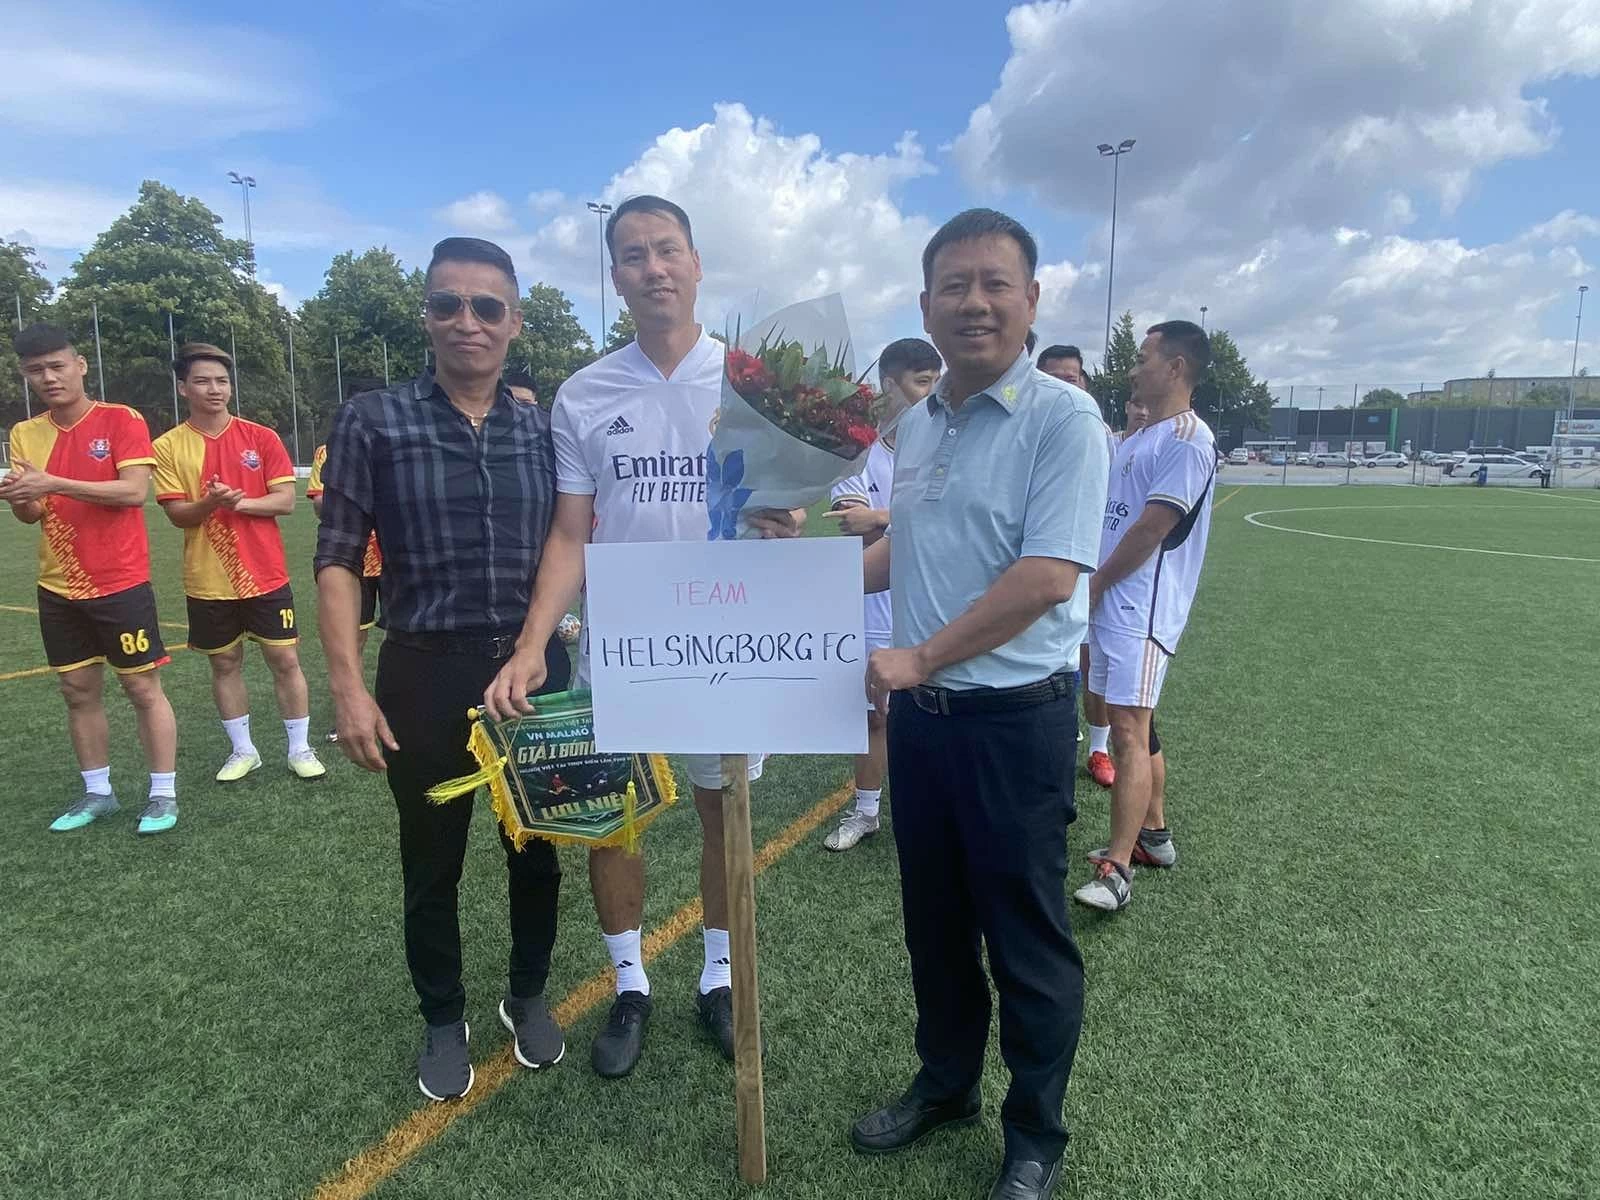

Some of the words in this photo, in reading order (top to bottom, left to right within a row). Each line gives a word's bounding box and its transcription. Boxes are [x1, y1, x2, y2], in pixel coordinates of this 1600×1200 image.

[606, 427, 634, 436] adidas
[611, 450, 707, 480] Emirat
[632, 482, 656, 503] FLY
[660, 481, 706, 502] BETTE
[671, 581, 748, 606] TEAM
[279, 608, 294, 629] 19
[119, 629, 149, 655] 86
[823, 632, 859, 664] FC
[526, 732, 543, 741] VN
